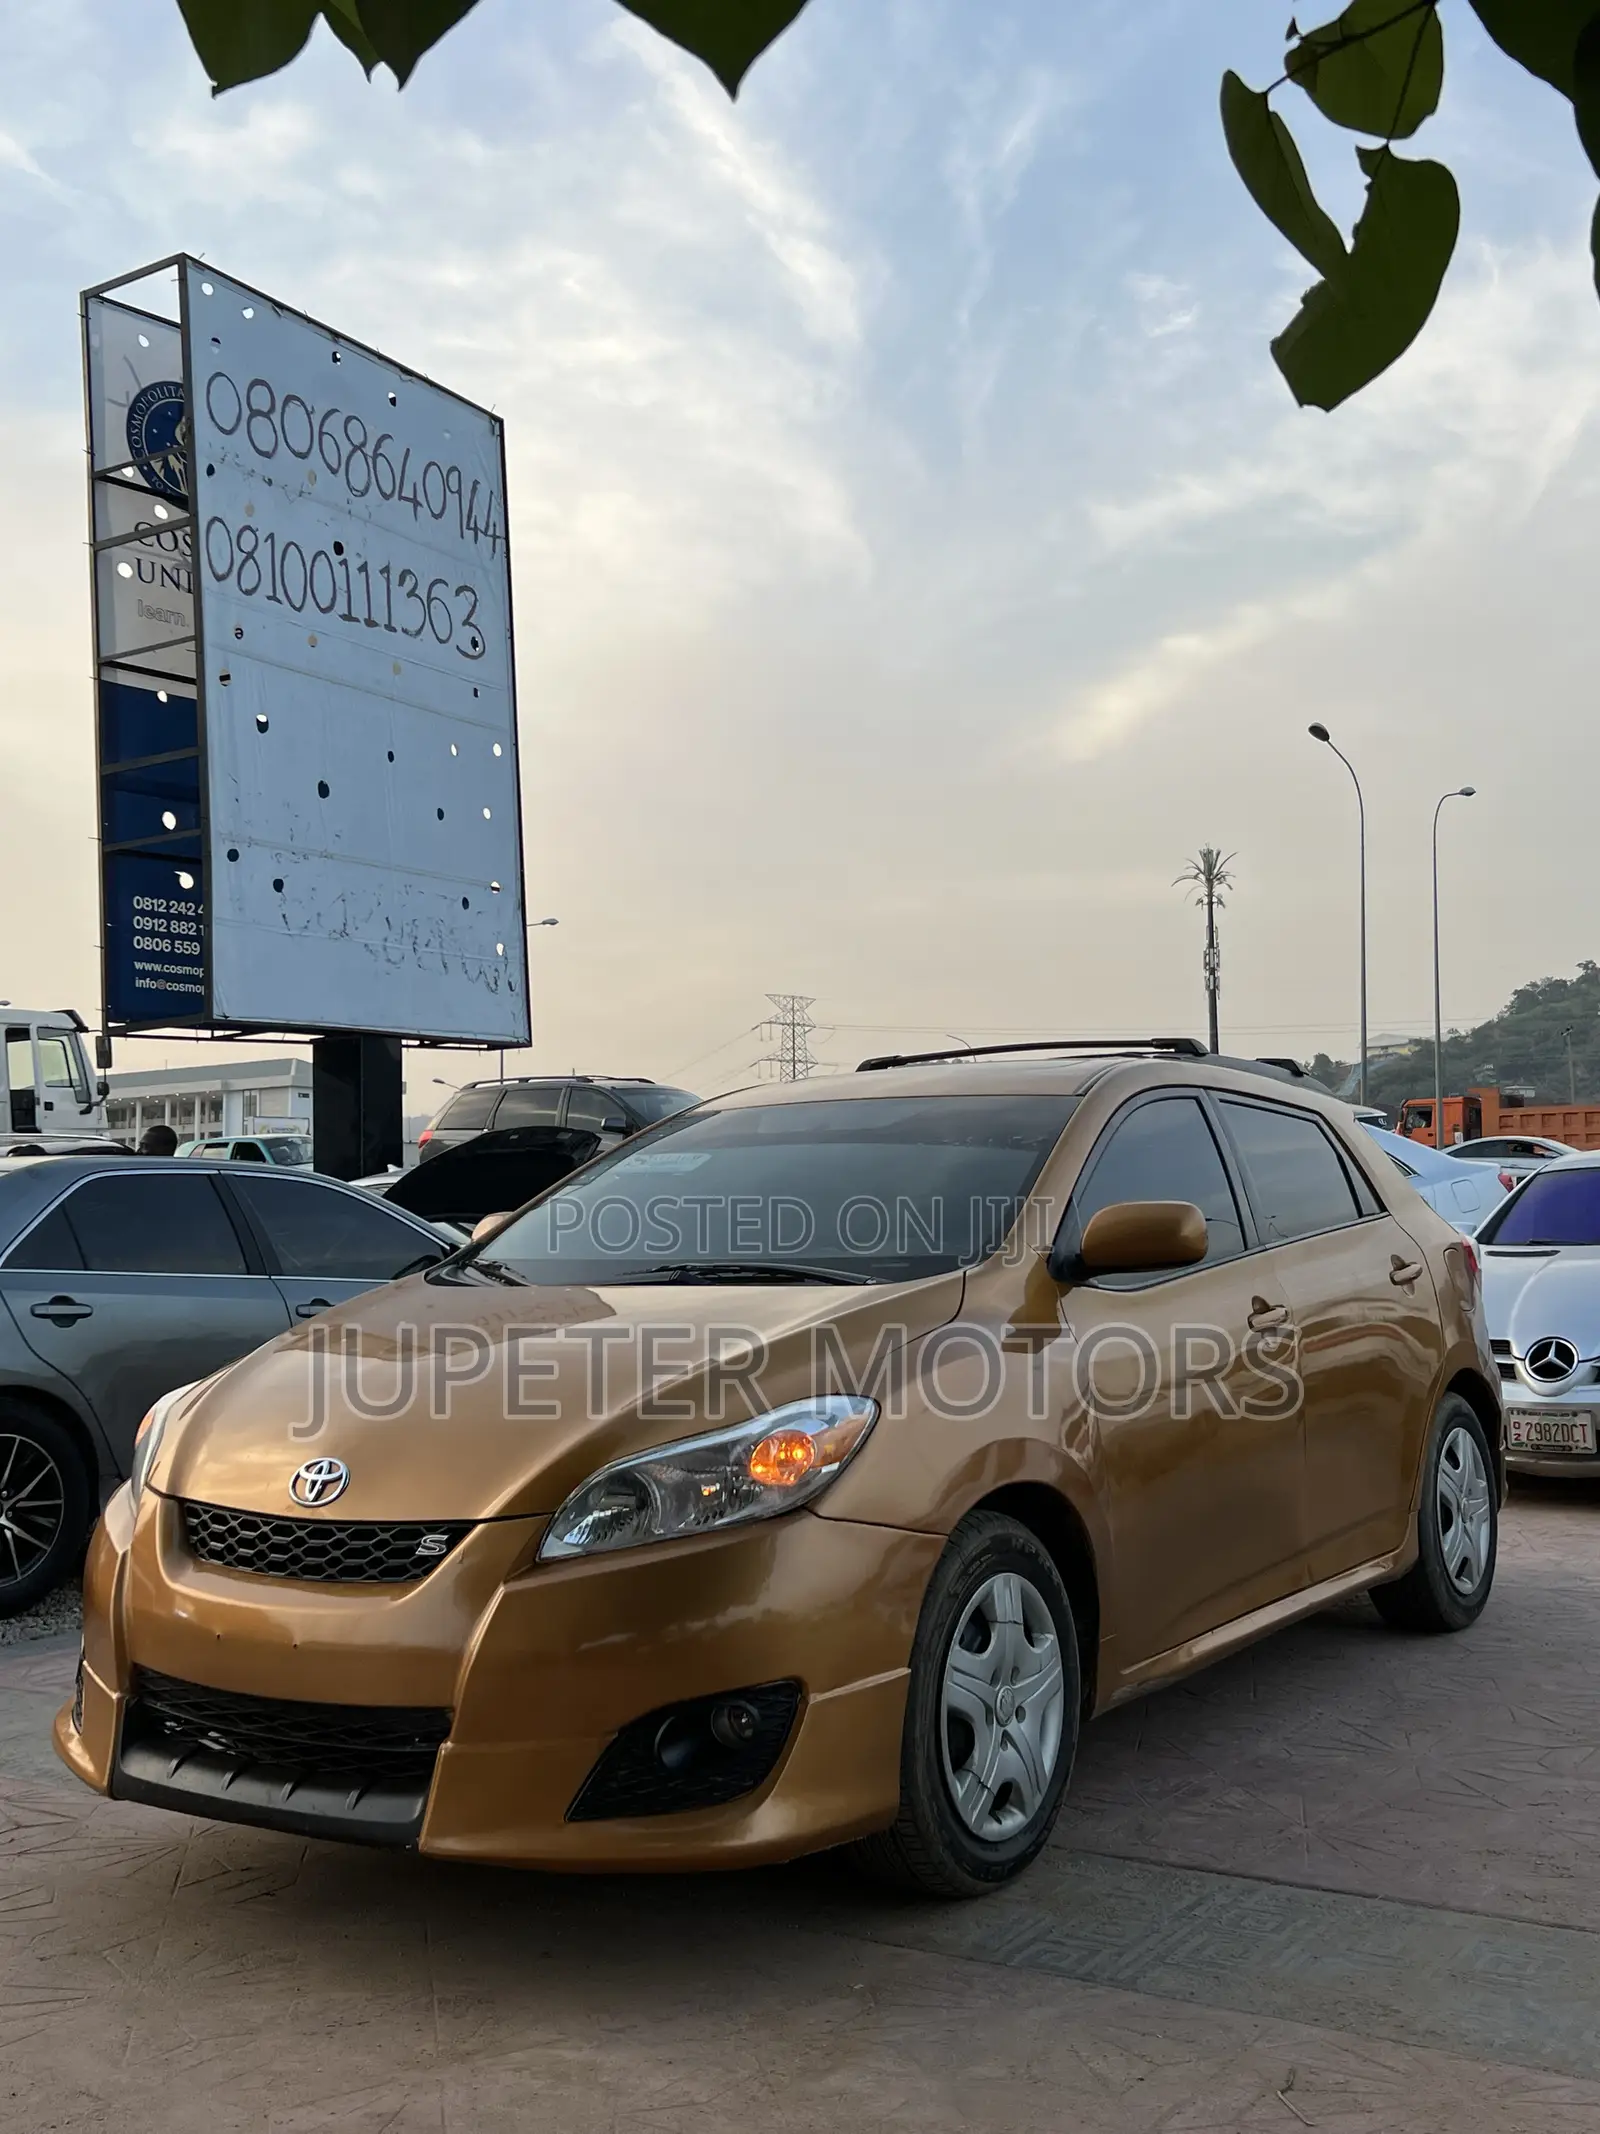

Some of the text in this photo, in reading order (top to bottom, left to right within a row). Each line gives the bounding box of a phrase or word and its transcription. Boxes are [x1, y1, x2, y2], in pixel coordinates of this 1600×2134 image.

[206, 371, 506, 559] 08068640944
[206, 516, 486, 660] 08100111363
[132, 895, 167, 913] 0812
[169, 900, 196, 916] 242
[132, 915, 168, 933] 0912
[170, 920, 197, 936] 882
[132, 935, 201, 955] 0806 559
[415, 1534, 449, 1556] S
